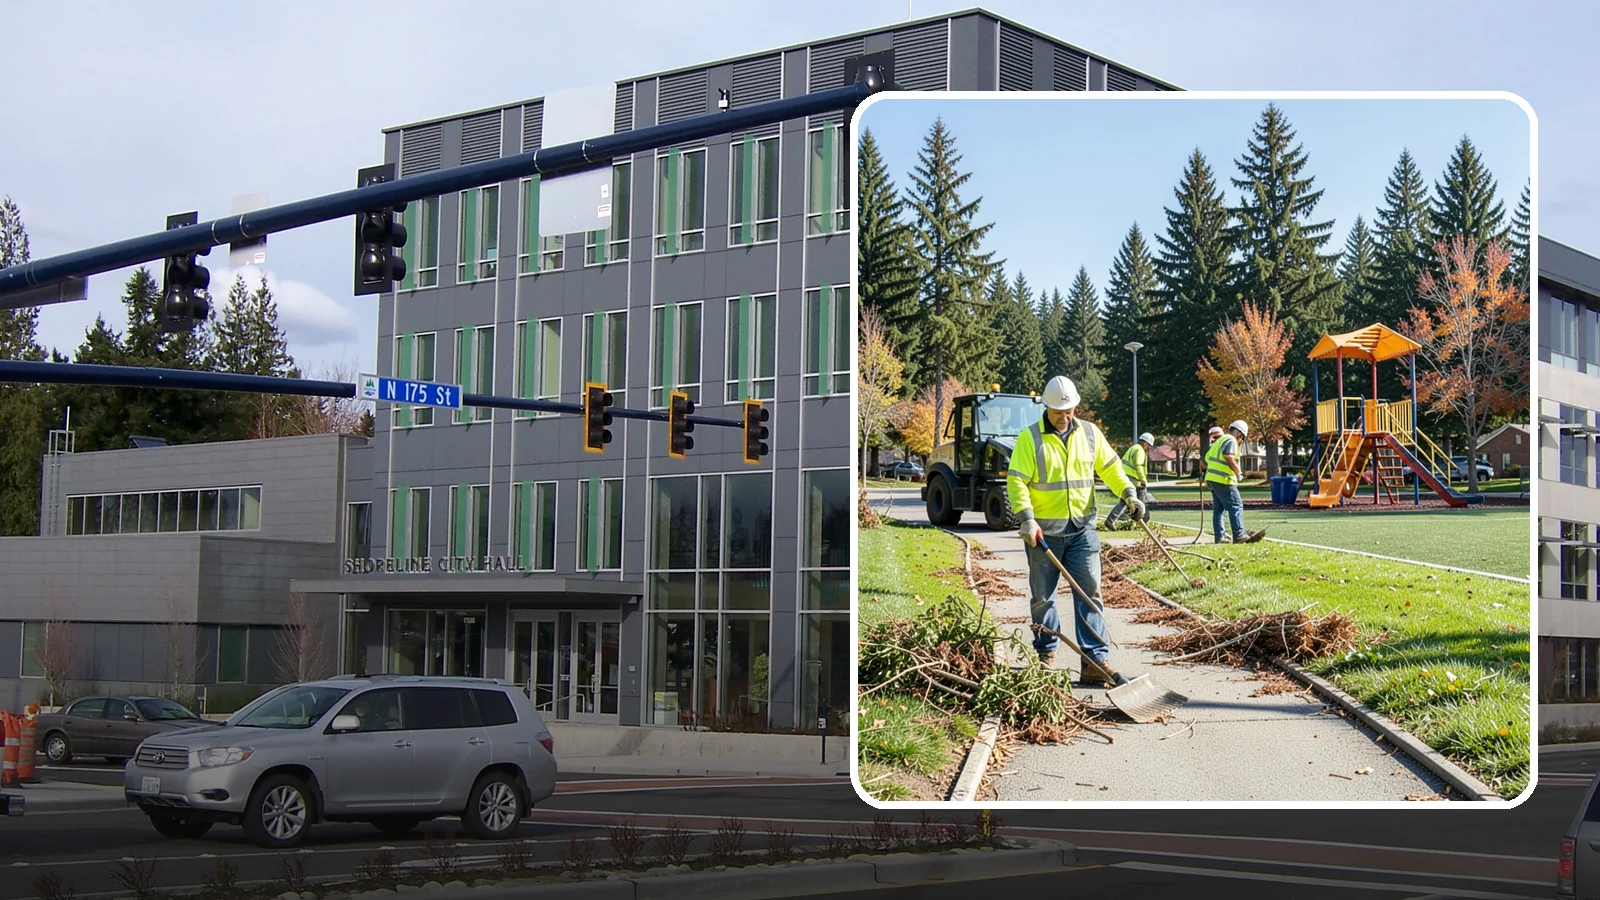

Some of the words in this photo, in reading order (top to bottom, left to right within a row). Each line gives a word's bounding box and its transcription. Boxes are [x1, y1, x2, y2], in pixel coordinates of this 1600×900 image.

[387, 380, 396, 400] N
[405, 382, 428, 403] 175
[436, 386, 451, 406] St
[344, 556, 432, 574] SHORELINE
[438, 555, 476, 573] CITY
[483, 554, 526, 572] HALL
